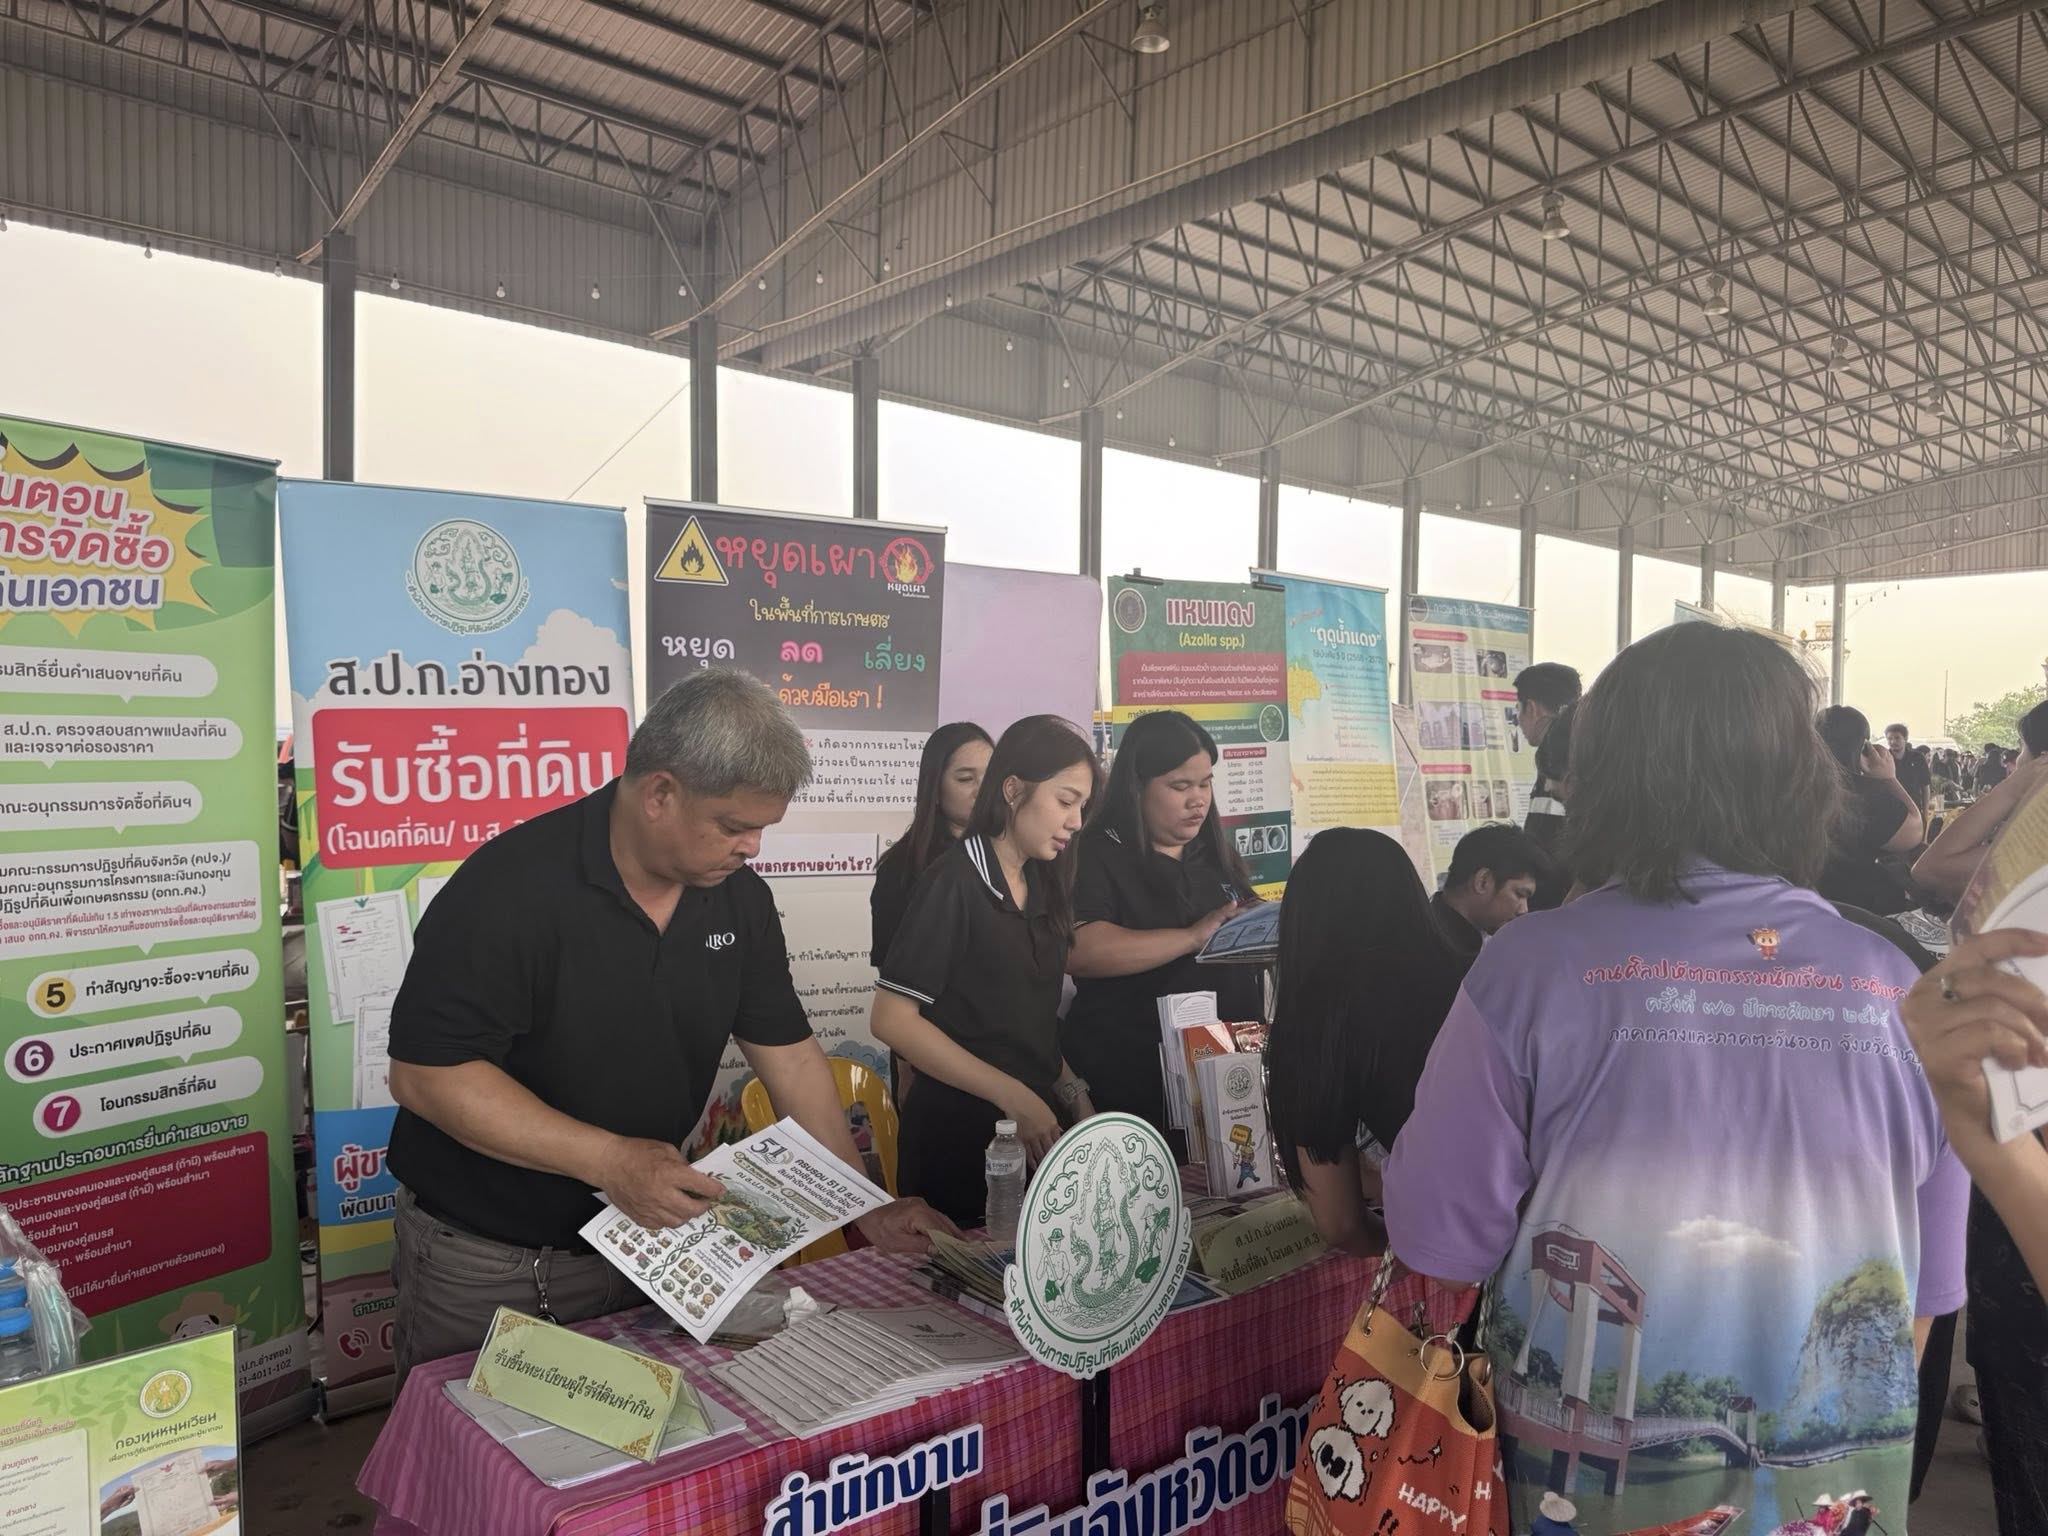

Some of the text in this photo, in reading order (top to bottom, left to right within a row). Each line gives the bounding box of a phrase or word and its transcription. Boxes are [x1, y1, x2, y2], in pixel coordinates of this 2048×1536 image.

[715, 536, 876, 588] หยุดเผา
[887, 582, 926, 595] หยุดเผา
[750, 597, 890, 628] ในพื้นที่การเกษตร
[1167, 599, 1255, 627] แหนแดง
[661, 634, 927, 672] หยุด ลด เลี่ยง
[1179, 633, 1246, 650] (Azolla spp.)
[328, 650, 611, 696] ส.ป.ก.อ่างทอง
[4, 719, 227, 738] ส.ป.ก. ตรวจสอบสภาพแปลงที่ดิน
[4, 738, 154, 754] และเจรจาต่อรองราคา
[331, 723, 614, 807] รับซื้อที่ดิน
[326, 815, 455, 855] (โฉนดที่ดิน/
[191, 851, 232, 869] (คปจ.)/
[107, 911, 119, 920] 1.5
[46, 961, 250, 1009] 5 ทำสัญญาจะซื้อจะขายที่ดิน
[1584, 954, 1843, 991] งานศิลปหัตถกรรมนักเรียน
[1645, 986, 1697, 1014] ครั้งที่
[1702, 999, 1736, 1017] ๗๐
[1742, 996, 1835, 1022] ปีการศึกษา
[24, 1020, 212, 1072] 6 ประกาศเขตปฏิรูปที่ดิน
[1608, 1026, 1833, 1052] ภาคกลางและภาคตะวันออก
[51, 1074, 217, 1128] 7 โอนกรรมสิทธิ์ที่ดิน
[750, 1137, 788, 1159] 51
[1, 1162, 173, 1213] ัวประชาชนของตนเองและของคู่สมรส
[203, 1143, 255, 1163] พร้อมสำเนา
[156, 1169, 211, 1190] พร้อมสำเนา
[795, 1159, 829, 1183] ครบรอบ
[24, 1220, 79, 1242] ร้อมสำเนา
[75, 1239, 133, 1263] พร้อมสำเนา
[1010, 1241, 1191, 1374] สำนักงานการปฏิรูปที่ดินเพื่อเกษตรกรรม
[115, 1412, 217, 1450] กองทุนหมุนเวียน
[771, 1430, 980, 1536] สำนักงาน
[1397, 1482, 1467, 1532] HAPPY
